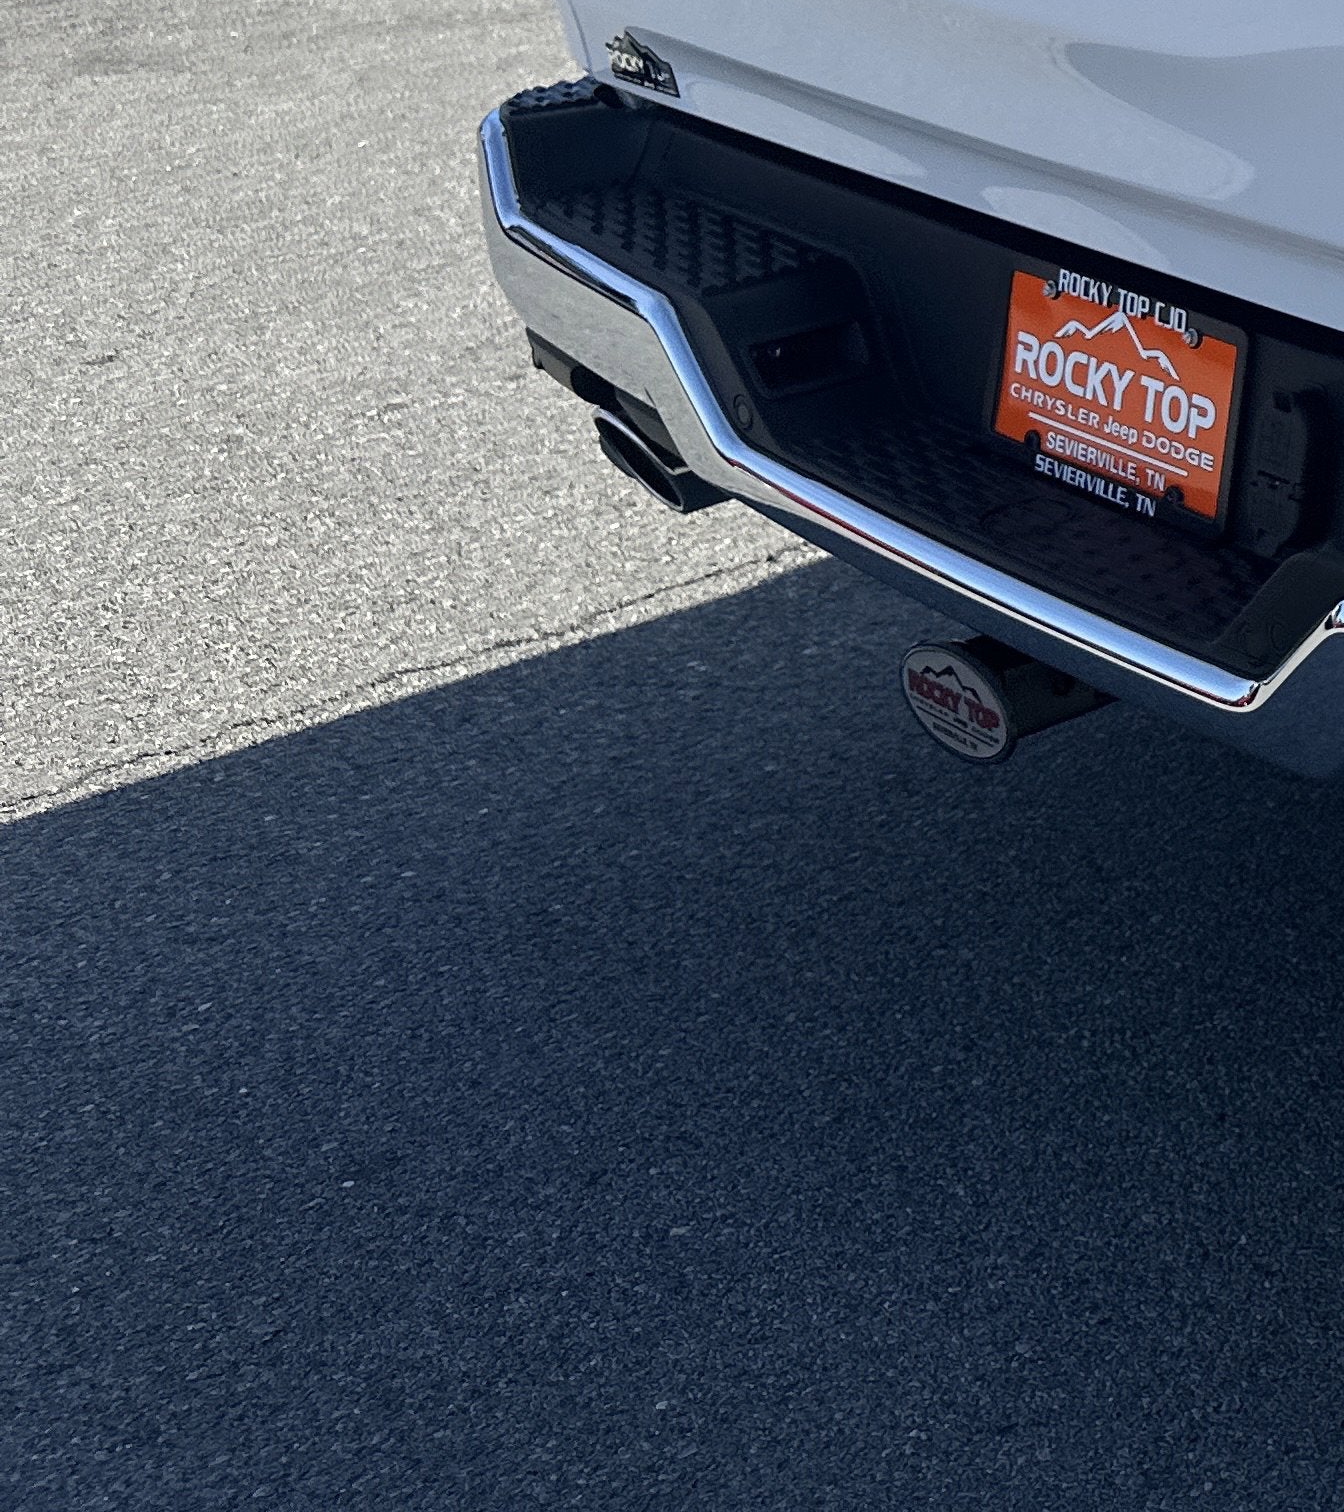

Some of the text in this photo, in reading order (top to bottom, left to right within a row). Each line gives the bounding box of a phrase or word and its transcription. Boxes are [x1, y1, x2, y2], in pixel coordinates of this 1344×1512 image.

[1058, 268, 1112, 307] ROCKY
[1117, 288, 1150, 319] TOP
[1014, 331, 1217, 439] ROCKY TOP
[1009, 382, 1214, 472] CHRYSLER Jeep DODGE
[1034, 454, 1156, 517] SEVIERVILLE, TN
[1045, 432, 1166, 492] SEVIERVILLE, TN
